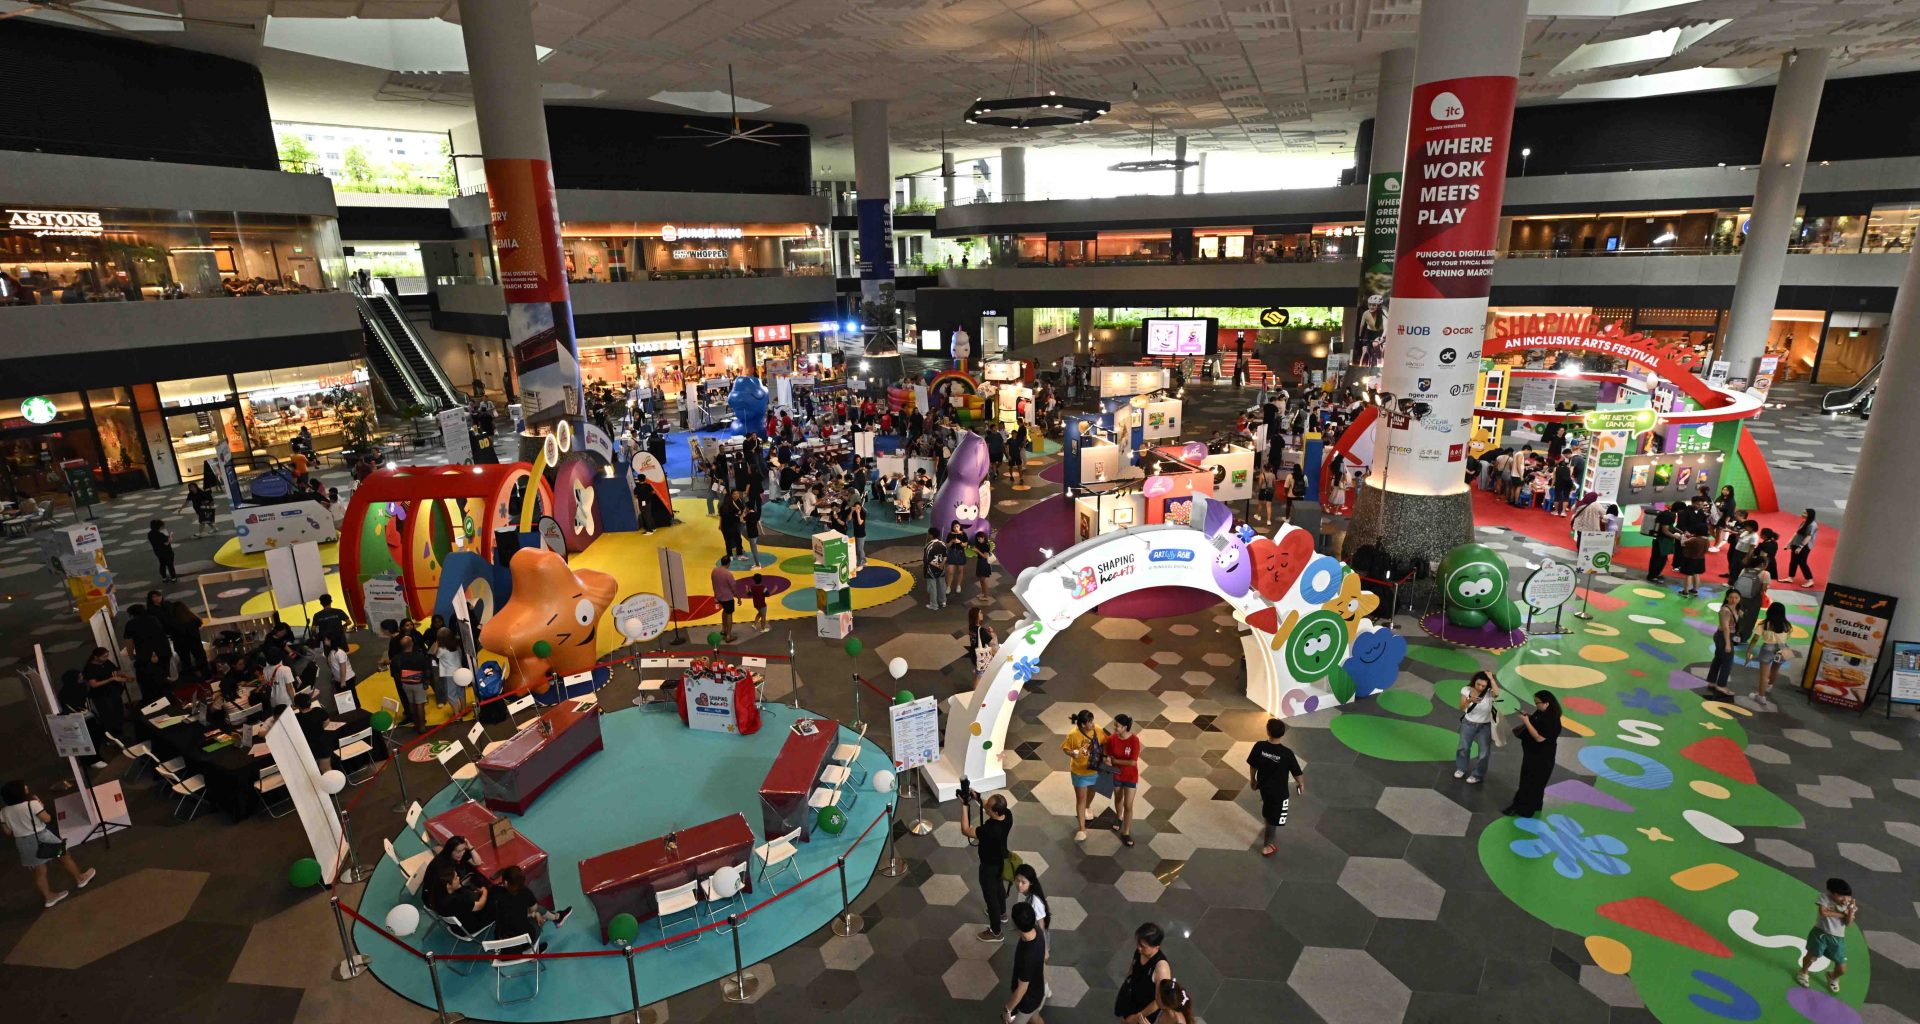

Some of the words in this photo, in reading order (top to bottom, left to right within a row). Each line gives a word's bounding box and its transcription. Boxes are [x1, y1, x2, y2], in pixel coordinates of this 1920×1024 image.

[1445, 106, 1461, 117] jtc
[1426, 136, 1493, 157] WHERE
[1423, 160, 1486, 180] WORK
[1420, 184, 1480, 202] MEETS
[8, 212, 102, 227] ASTONS
[1417, 207, 1467, 225] PLAY
[689, 250, 728, 258] WHOPPER
[1415, 250, 1457, 259] PUNGGOL
[1458, 249, 1486, 258] DIGITAL
[1422, 269, 1465, 278] OPENING
[1466, 268, 1490, 277] MARCH
[1406, 325, 1431, 336] UOB
[1452, 327, 1473, 335] OCBC
[1494, 312, 1600, 338] SHAPING
[1504, 337, 1519, 348] AN
[1523, 336, 1580, 346] INCLUSIVE
[1584, 337, 1611, 351] ARTS
[1611, 343, 1660, 368] FESTIVAL
[1097, 553, 1135, 574] SHAPING
[1100, 564, 1136, 585] hearts
[1835, 618, 1872, 631] GOLDEN
[1833, 626, 1869, 641] BUBBLE
